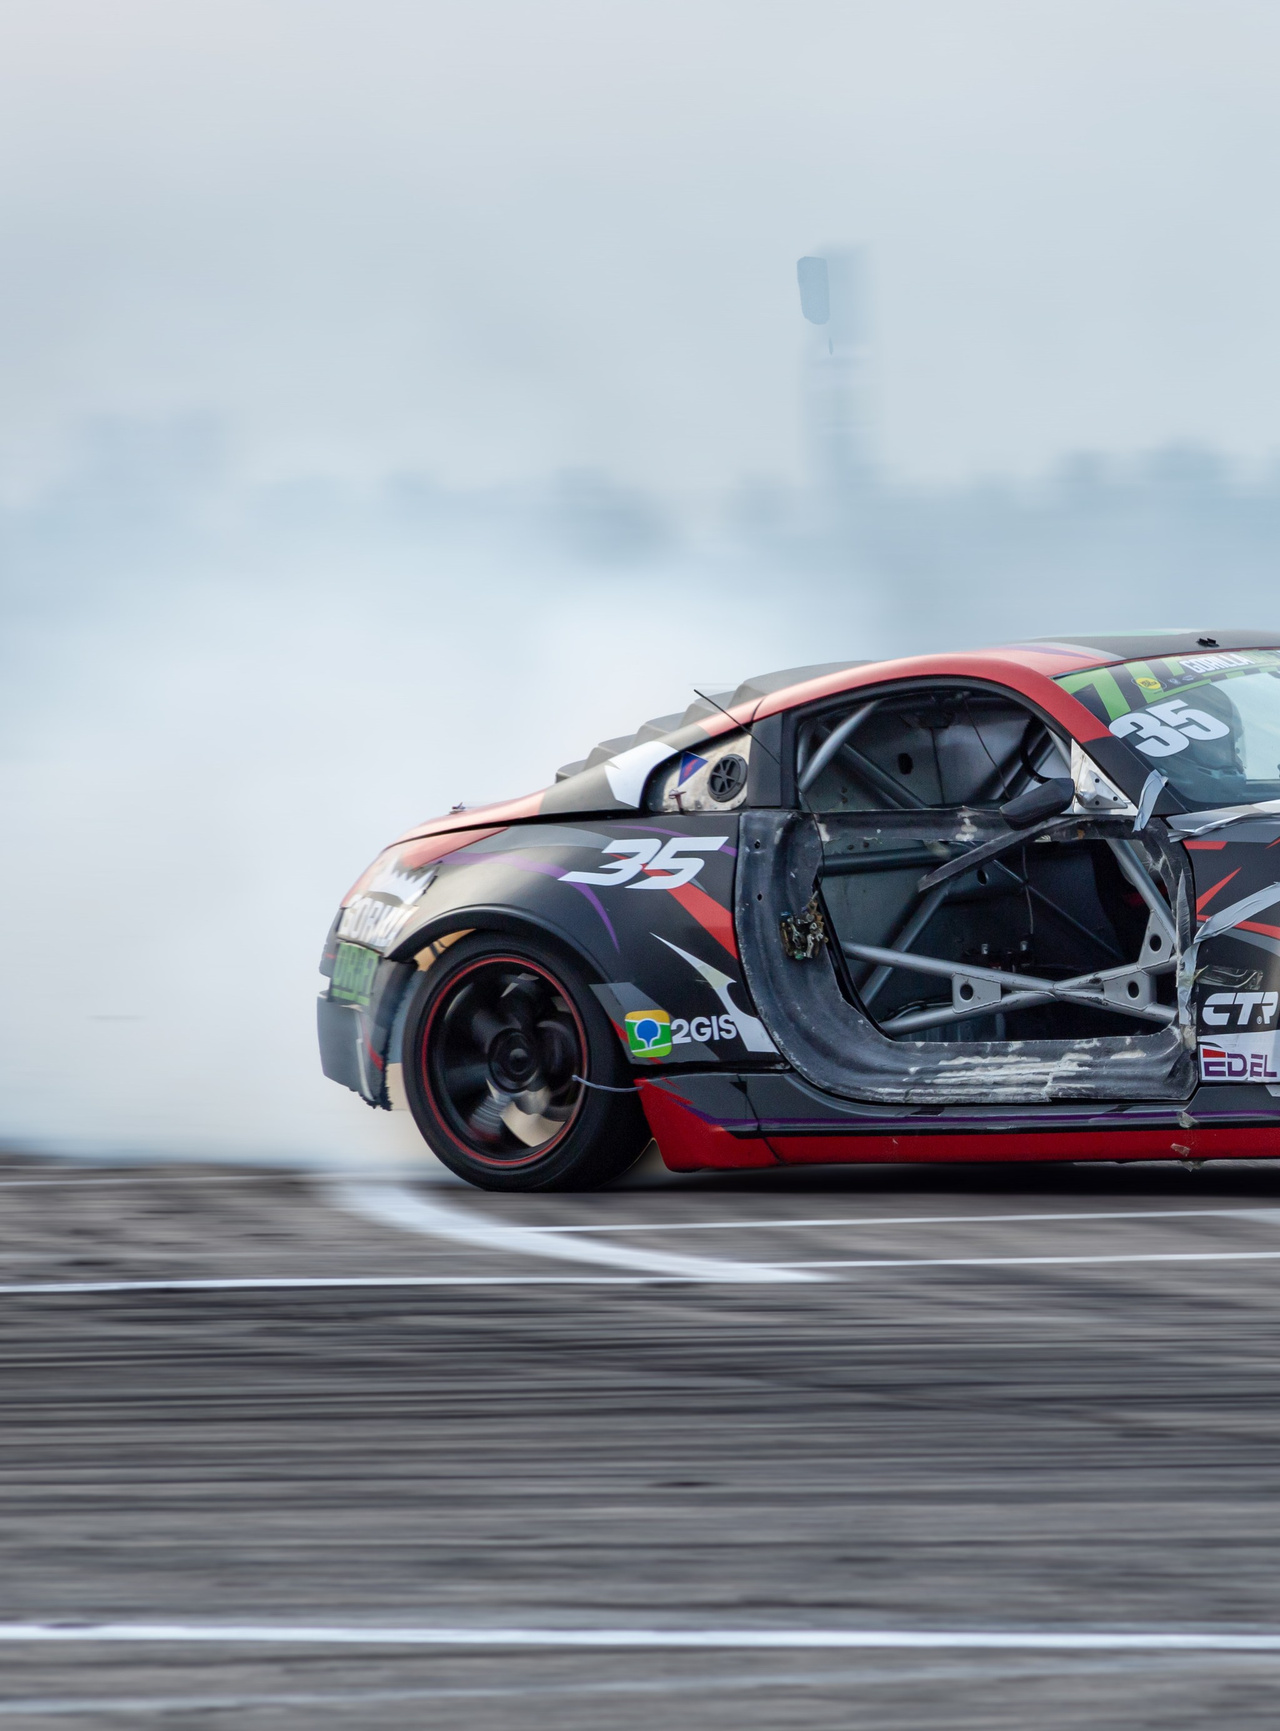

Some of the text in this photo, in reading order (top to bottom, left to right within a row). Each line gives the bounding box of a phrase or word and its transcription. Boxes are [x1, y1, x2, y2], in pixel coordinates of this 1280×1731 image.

[1179, 653, 1255, 674] GORILLA
[1108, 699, 1230, 758] 35
[557, 836, 730, 890] 35
[1201, 991, 1279, 1026] CTR
[670, 1014, 738, 1045] 2GIS
[1202, 1048, 1278, 1078] EDEL
